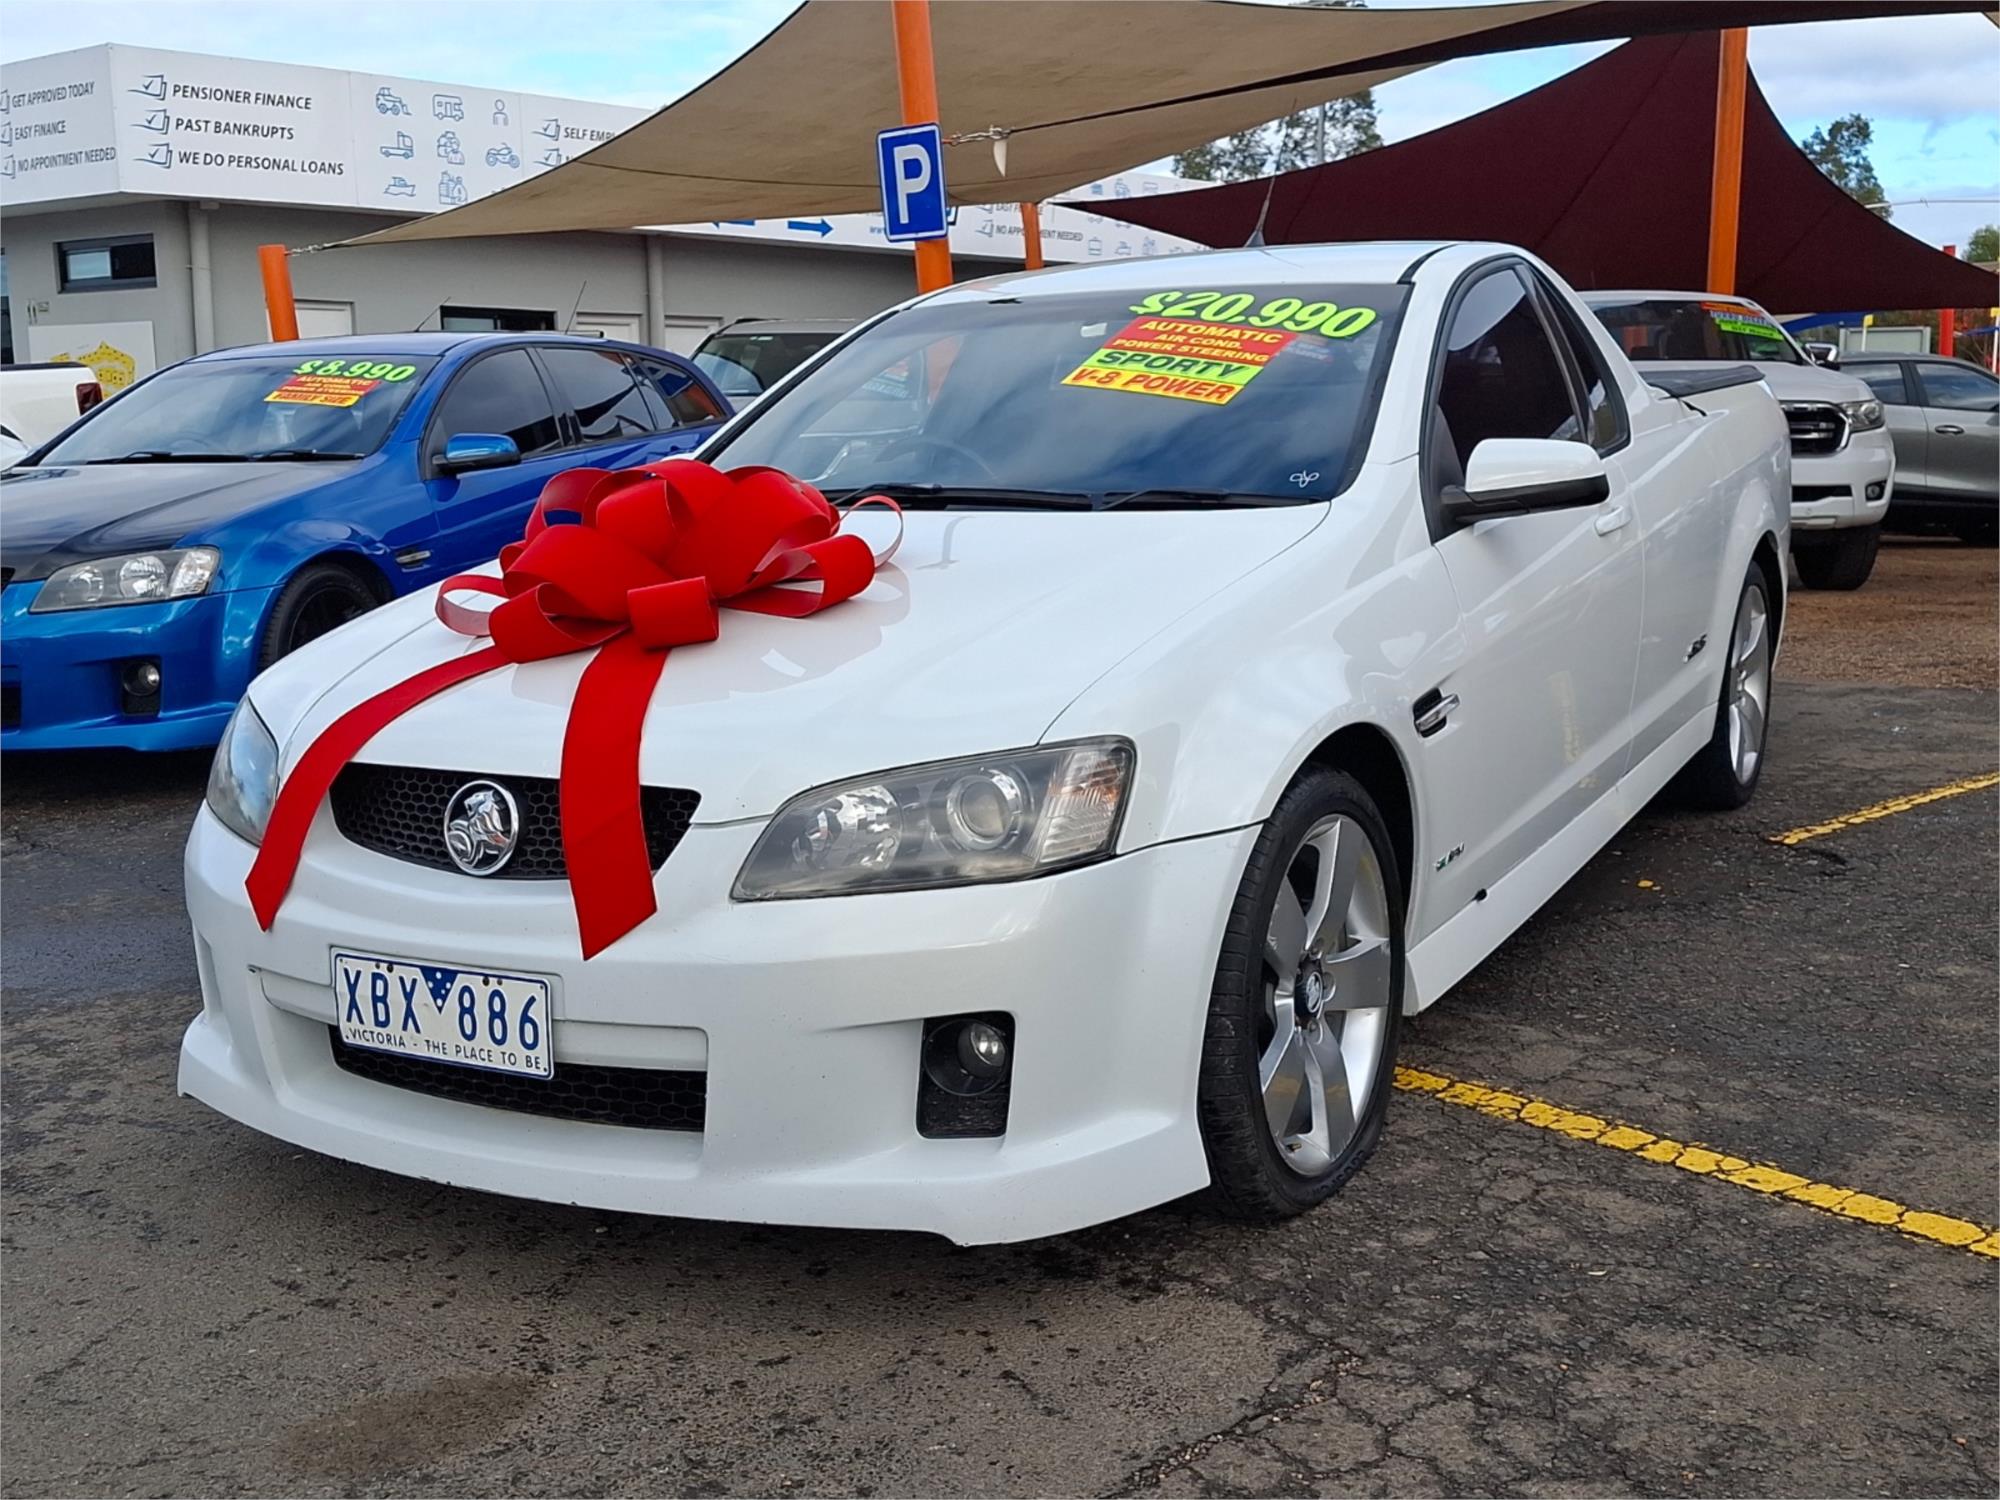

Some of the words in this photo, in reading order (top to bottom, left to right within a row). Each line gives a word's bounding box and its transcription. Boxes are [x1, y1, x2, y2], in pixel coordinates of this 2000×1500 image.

[12, 93, 25, 107] GET
[27, 86, 67, 105] APPROVED
[68, 81, 95, 98] TODAY
[173, 83, 251, 104] PENSIONER
[255, 92, 312, 109] FINANCE
[15, 126, 32, 140] EASY
[34, 120, 66, 137] FINANCE
[175, 118, 211, 132] PAST
[214, 121, 294, 140] BANKRUPTS
[564, 127, 588, 139] SELF
[18, 159, 28, 172] NO
[30, 151, 83, 170] APPOINTMENT
[85, 147, 116, 162] NEEDED
[178, 151, 200, 165] WE
[203, 153, 225, 166] DO
[228, 154, 298, 172] PERSONAL
[301, 160, 344, 175] LOANS
[893, 143, 932, 225] P
[996, 225, 1007, 234] NO
[1057, 230, 1083, 241] NEEDED
[1139, 320, 1283, 344] AUTOMATIC
[1154, 333, 1187, 343] AIR
[1192, 337, 1243, 349] COND.
[1112, 338, 1174, 351] POWER
[1177, 345, 1269, 363] STEERING
[1097, 350, 1246, 377] SPORTY
[1069, 366, 1121, 384] V-8
[1123, 374, 1236, 402] POWER
[343, 967, 421, 1034] XBX
[457, 985, 540, 1051] 886
[349, 1027, 406, 1048] VICTORIA
[424, 1039, 448, 1055] THE
[455, 1044, 493, 1063] PLACE
[501, 1051, 517, 1066] TO
